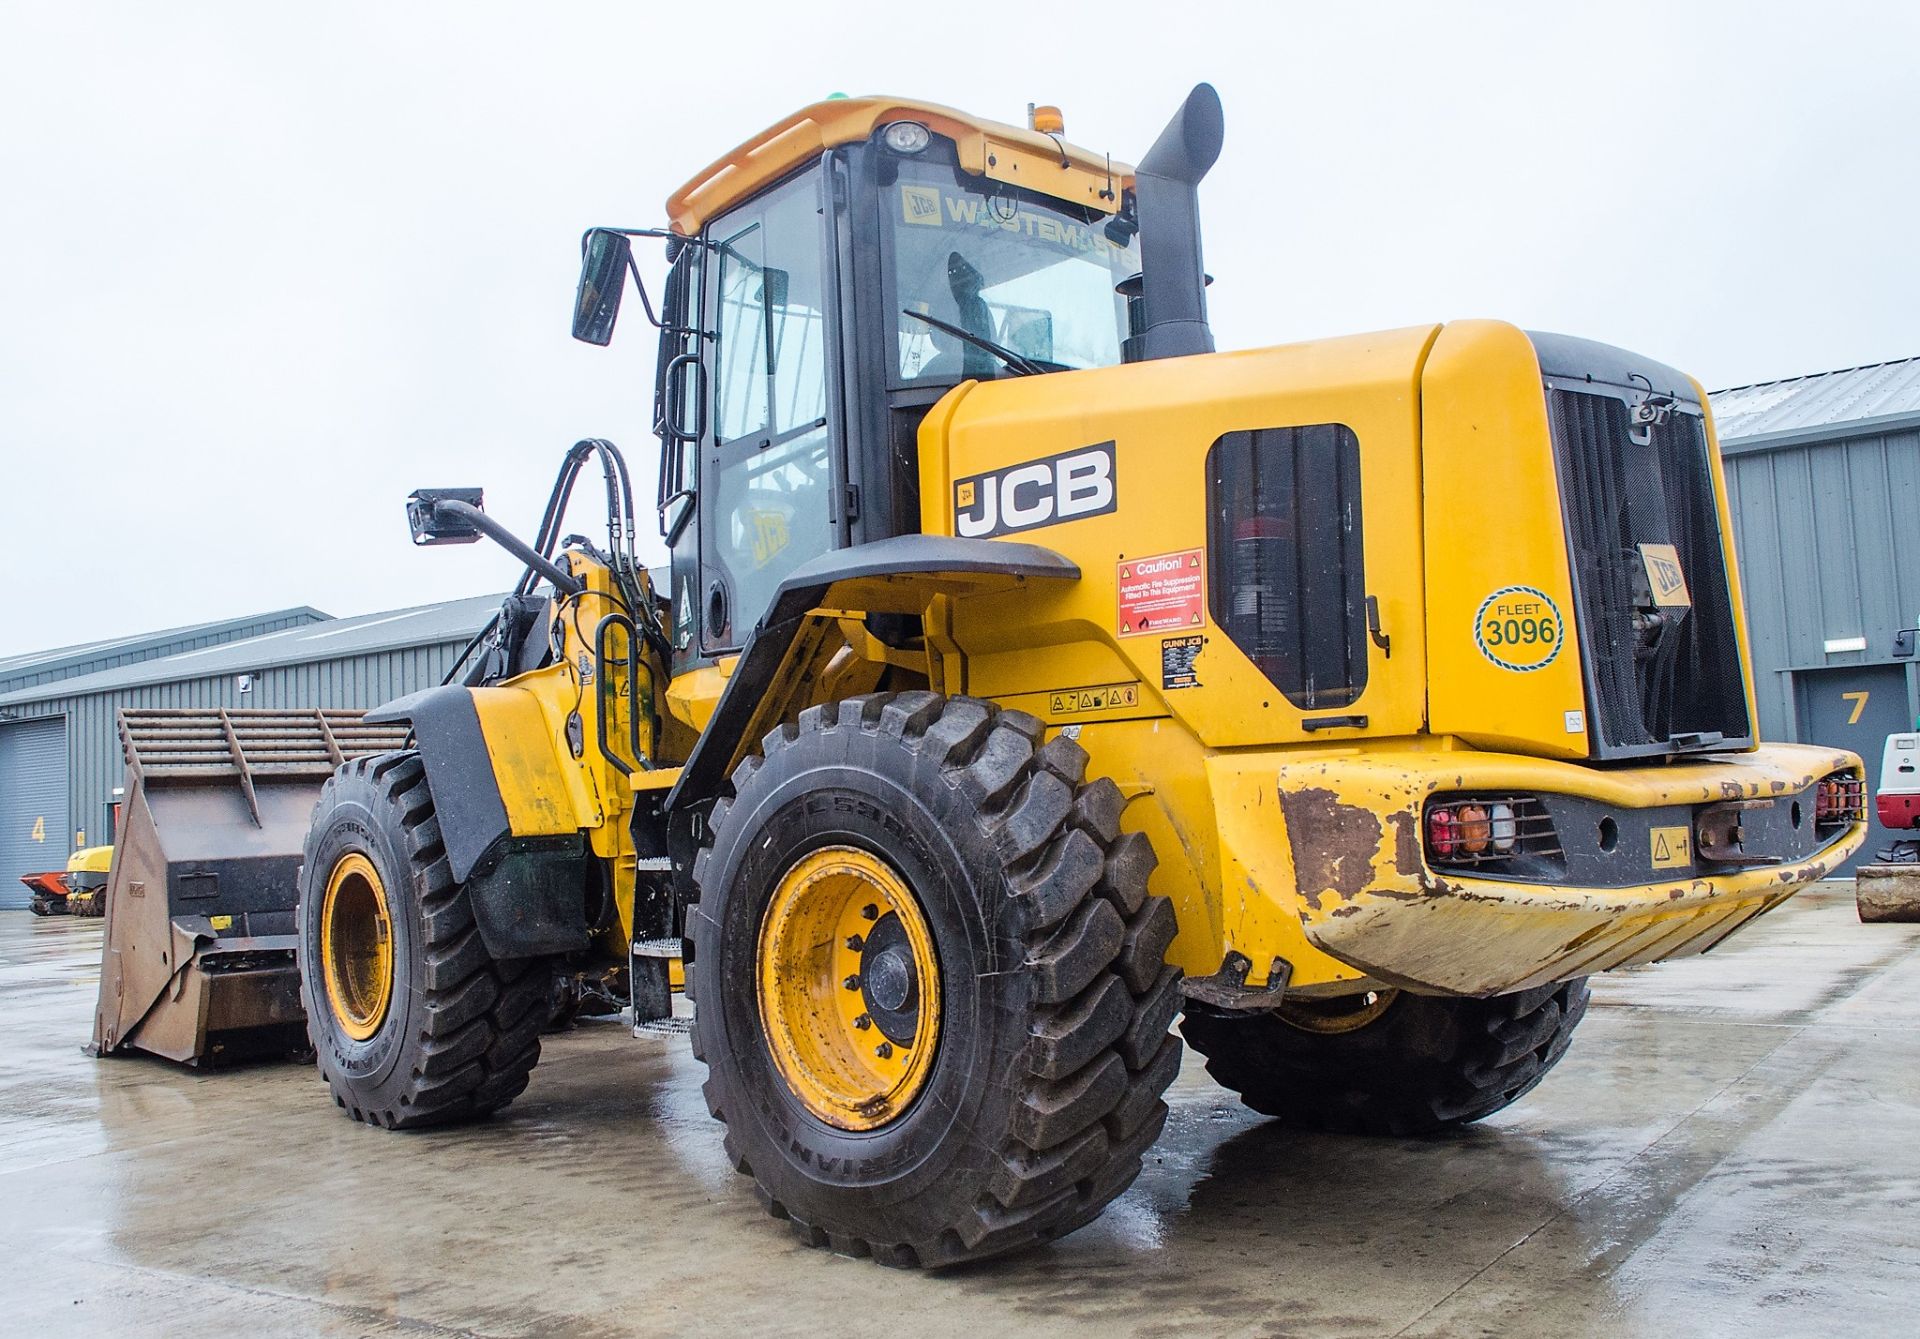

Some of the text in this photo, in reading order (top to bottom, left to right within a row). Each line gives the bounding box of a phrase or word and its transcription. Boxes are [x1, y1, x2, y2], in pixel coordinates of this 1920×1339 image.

[911, 194, 936, 216] JCB
[945, 197, 1141, 270] WASTEMASTE
[957, 450, 1113, 537] JCB
[1136, 557, 1182, 575] Caution!
[1652, 559, 1681, 591] JCB
[1120, 575, 1201, 593] Automatic Fire Suppression
[1125, 591, 1142, 600] Fitted
[1150, 588, 1161, 597] This
[1162, 583, 1196, 595] Equipment
[1497, 603, 1541, 616] FLEET
[1162, 637, 1202, 648] GUNN JCB
[1486, 618, 1555, 646] 3096
[1842, 691, 1870, 725] 7
[31, 815, 47, 844] 4
